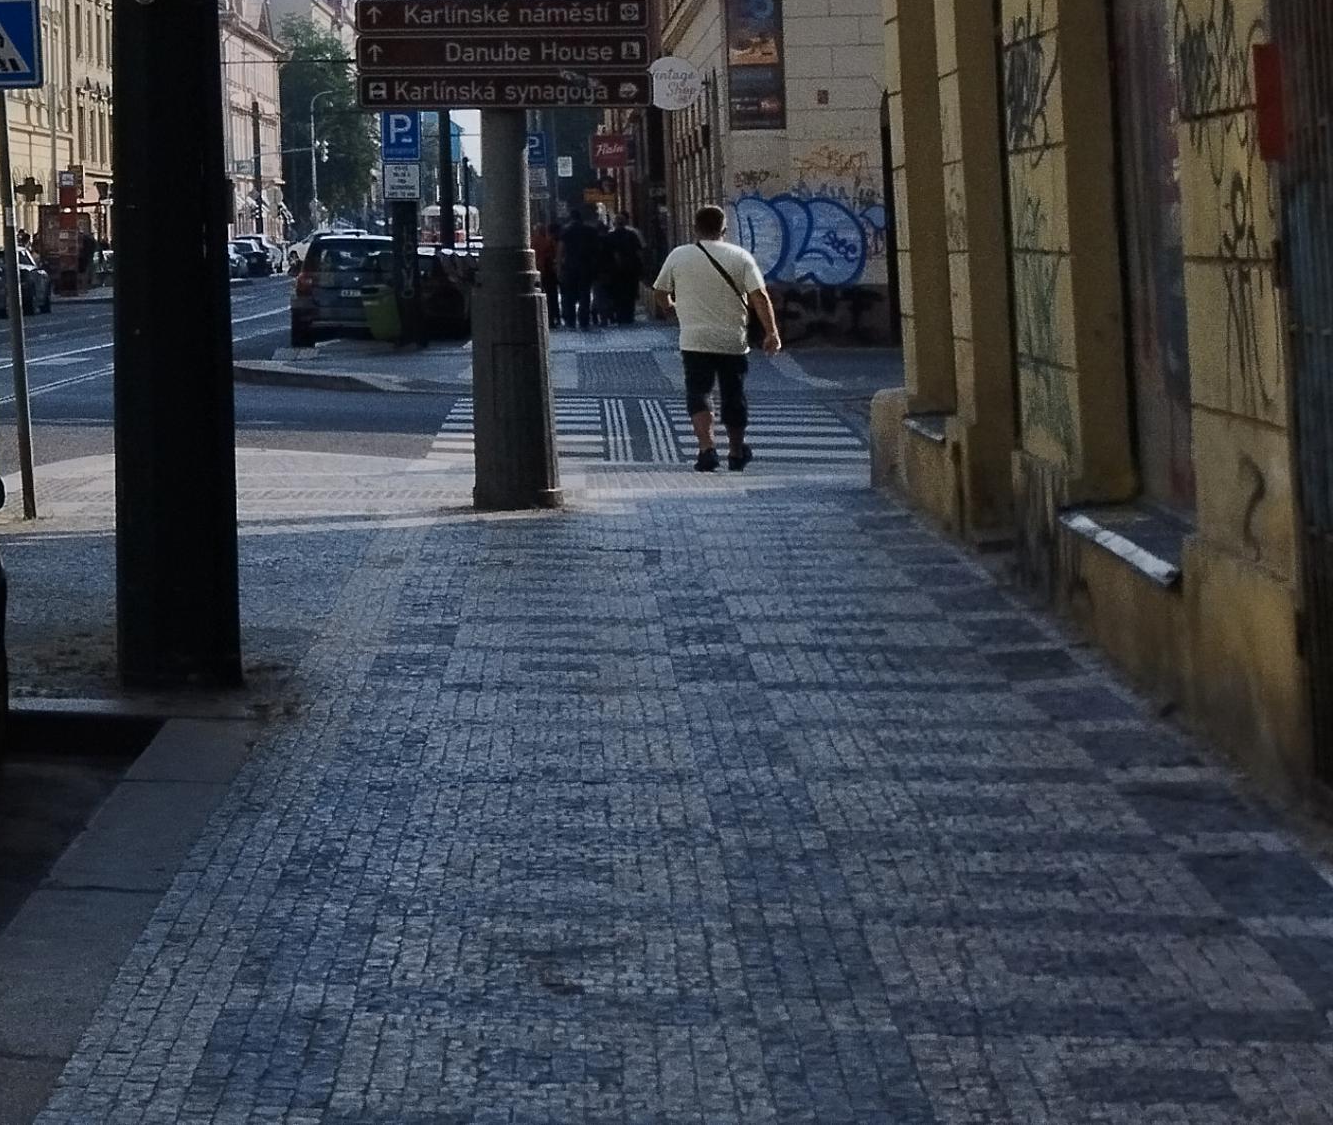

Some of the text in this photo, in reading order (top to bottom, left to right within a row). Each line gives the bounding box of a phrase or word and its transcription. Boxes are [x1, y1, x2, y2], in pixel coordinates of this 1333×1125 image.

[404, 2, 611, 24] Karlínské náměstí
[445, 41, 614, 62] Danube House
[394, 80, 609, 106] Karlínská synagoga
[389, 114, 412, 144] P
